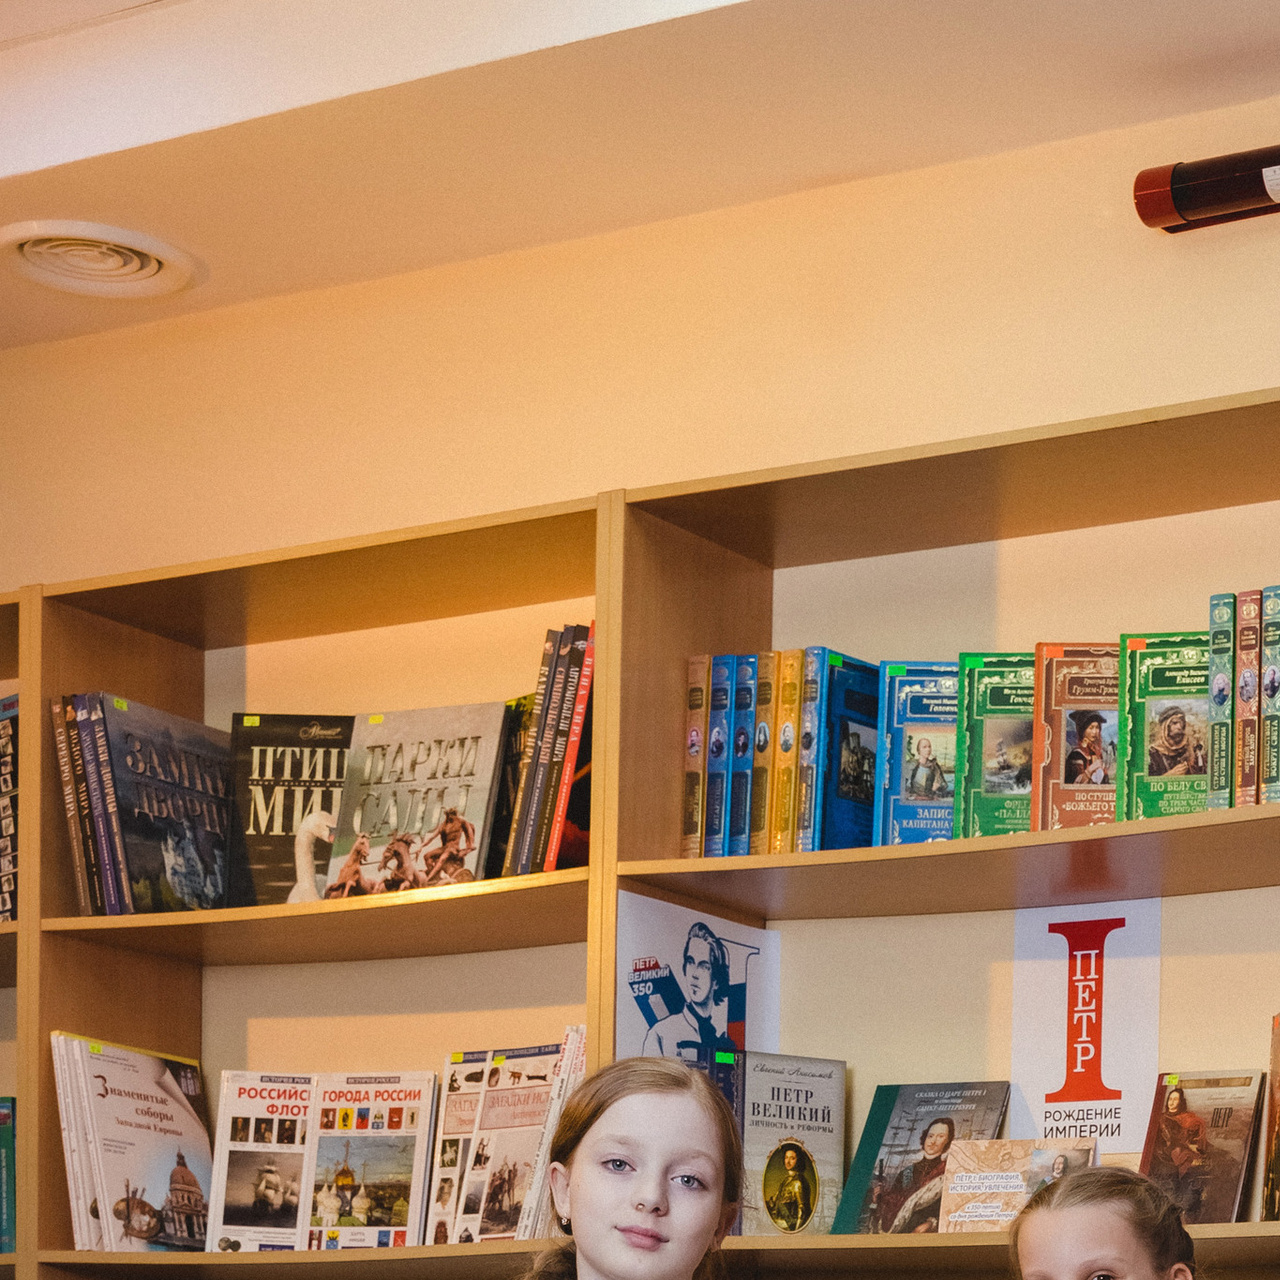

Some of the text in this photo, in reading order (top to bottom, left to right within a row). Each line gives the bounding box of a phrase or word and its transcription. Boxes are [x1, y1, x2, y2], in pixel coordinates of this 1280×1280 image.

[360, 736, 482, 786] ПАРКИ
[1151, 782, 1207, 792] ПО БЕЛУ СВ
[917, 809, 953, 818] ЗАПИС
[902, 820, 950, 829] КАПИТАНА
[632, 958, 657, 971] ПЕТР
[628, 964, 670, 983] ВЕЛИКИЙ
[632, 983, 653, 997] 350
[1073, 950, 1100, 1073] ПЕТР
[93, 1074, 169, 1107] Знаменитые
[323, 1089, 422, 1104] ГОРОДА РОССИИ
[771, 1086, 814, 1104] ПЕТР
[135, 1107, 175, 1123] соборы
[266, 1104, 310, 1117] ФЛОТ
[751, 1102, 832, 1124] ВЕЛИКИЙ
[1045, 1107, 1122, 1123] РОЖДЕНИЕ
[1210, 1107, 1234, 1128] ПЕТР
[750, 1119, 834, 1134] ЛИЧНОСТЬ РЕФОРМЫ
[1045, 1123, 1121, 1139] ИМПЕРИИ
[984, 1183, 1025, 1191] УВЛЕЧЕНИЯ
